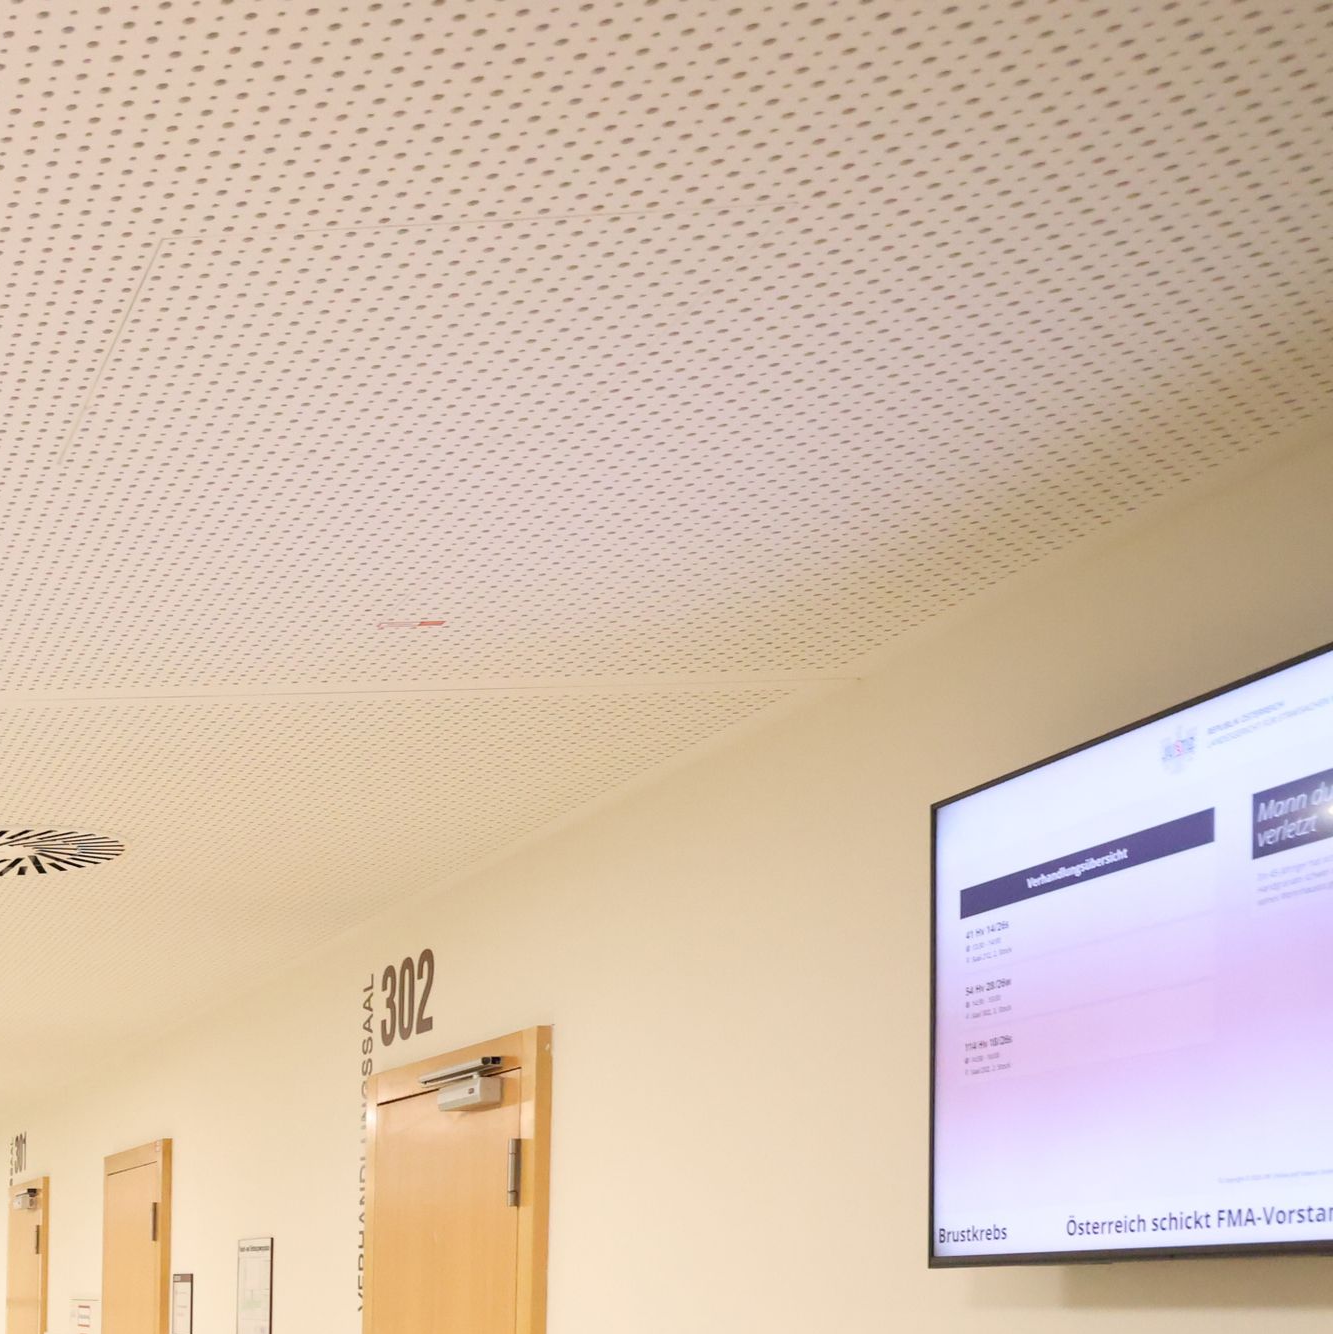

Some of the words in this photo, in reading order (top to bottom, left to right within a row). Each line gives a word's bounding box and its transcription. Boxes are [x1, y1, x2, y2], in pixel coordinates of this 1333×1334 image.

[1258, 794, 1308, 822] Mann
[1258, 815, 1317, 847] verletzt
[1026, 848, 1128, 889] Verhandlungsübersicht
[381, 948, 435, 1047] 302
[15, 1132, 27, 1174] 301
[938, 1224, 1008, 1244] Brustkrebs
[1066, 1214, 1146, 1236] Österreich
[1152, 1210, 1212, 1232] schickt
